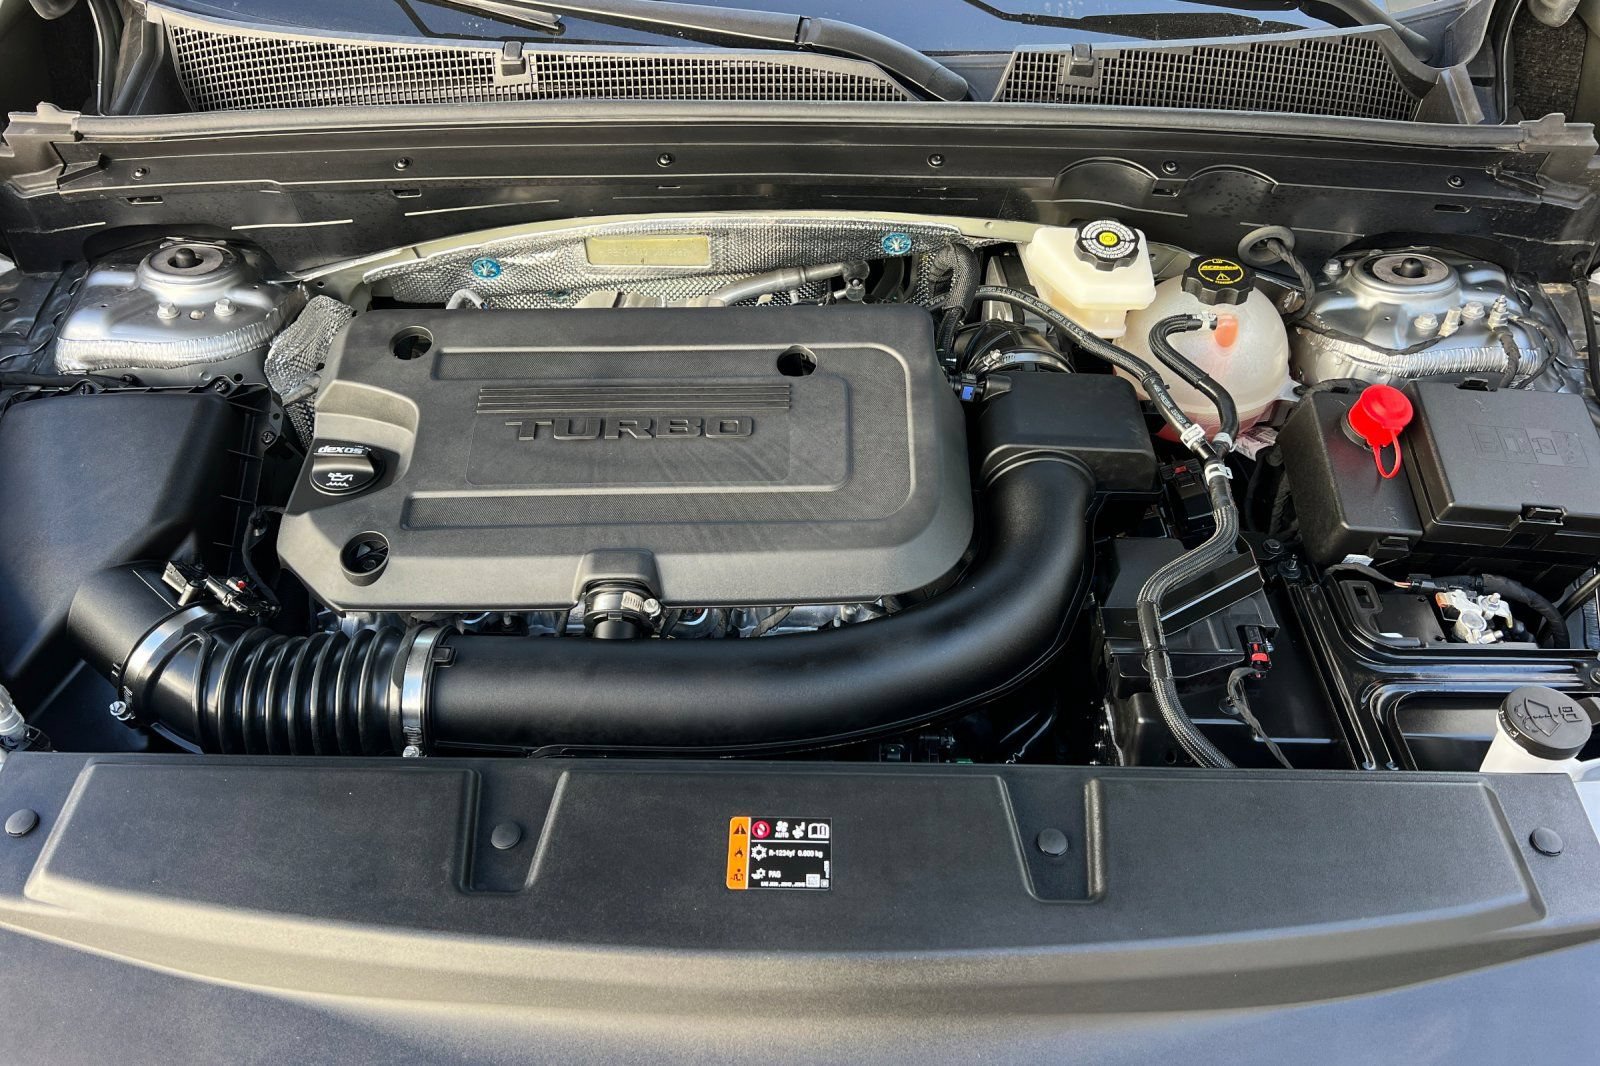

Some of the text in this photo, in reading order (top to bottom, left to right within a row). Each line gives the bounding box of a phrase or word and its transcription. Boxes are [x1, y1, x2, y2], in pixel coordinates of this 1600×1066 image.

[505, 417, 754, 441] TURBO
[317, 445, 364, 454] dexos
[768, 870, 781, 878] PAG
